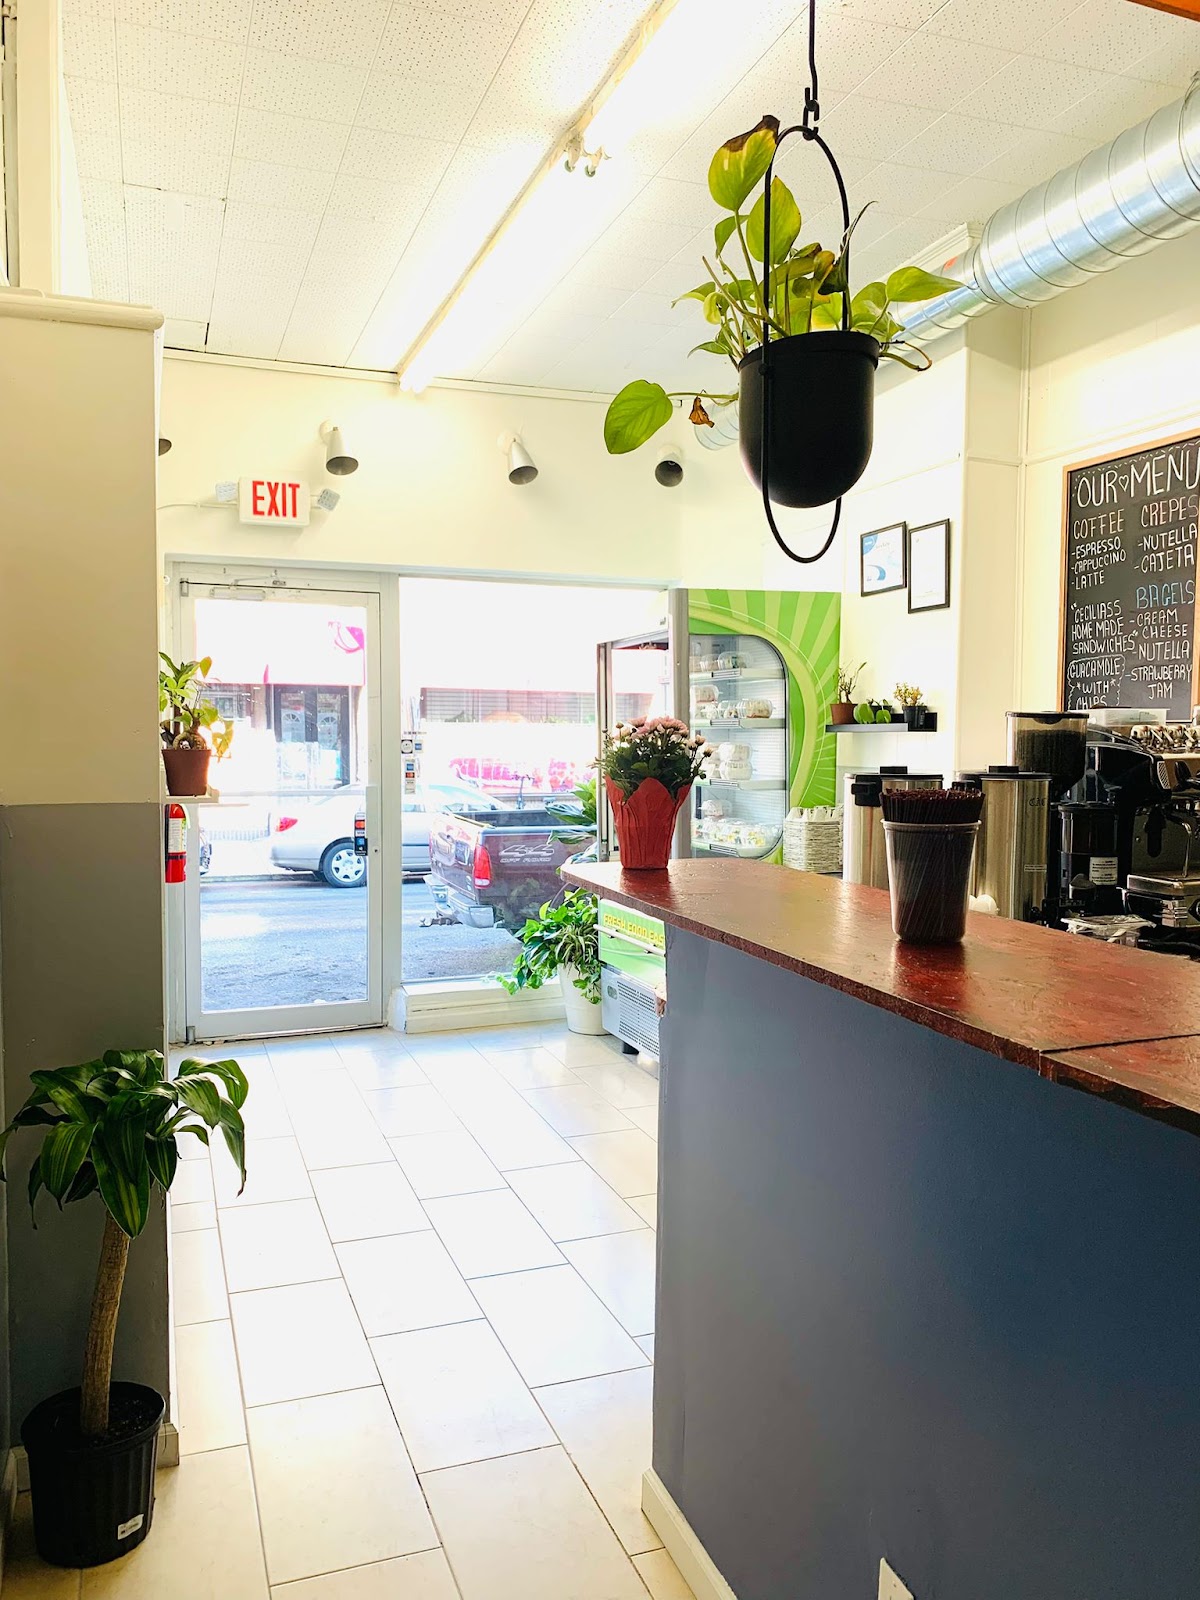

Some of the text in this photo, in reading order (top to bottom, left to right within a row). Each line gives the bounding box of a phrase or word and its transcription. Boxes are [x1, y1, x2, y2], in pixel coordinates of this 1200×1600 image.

[1077, 447, 1200, 507] OUR MENU
[252, 480, 300, 518] EXIT
[1141, 494, 1199, 528] CREPES
[1073, 508, 1125, 539] COFFEE
[1136, 580, 1195, 609] BAGELS
[1071, 616, 1125, 641] HOME MADE
[1142, 624, 1188, 639] CHEESE
[1069, 657, 1120, 679] GUACAMOLE
[1147, 682, 1173, 700] JAM
